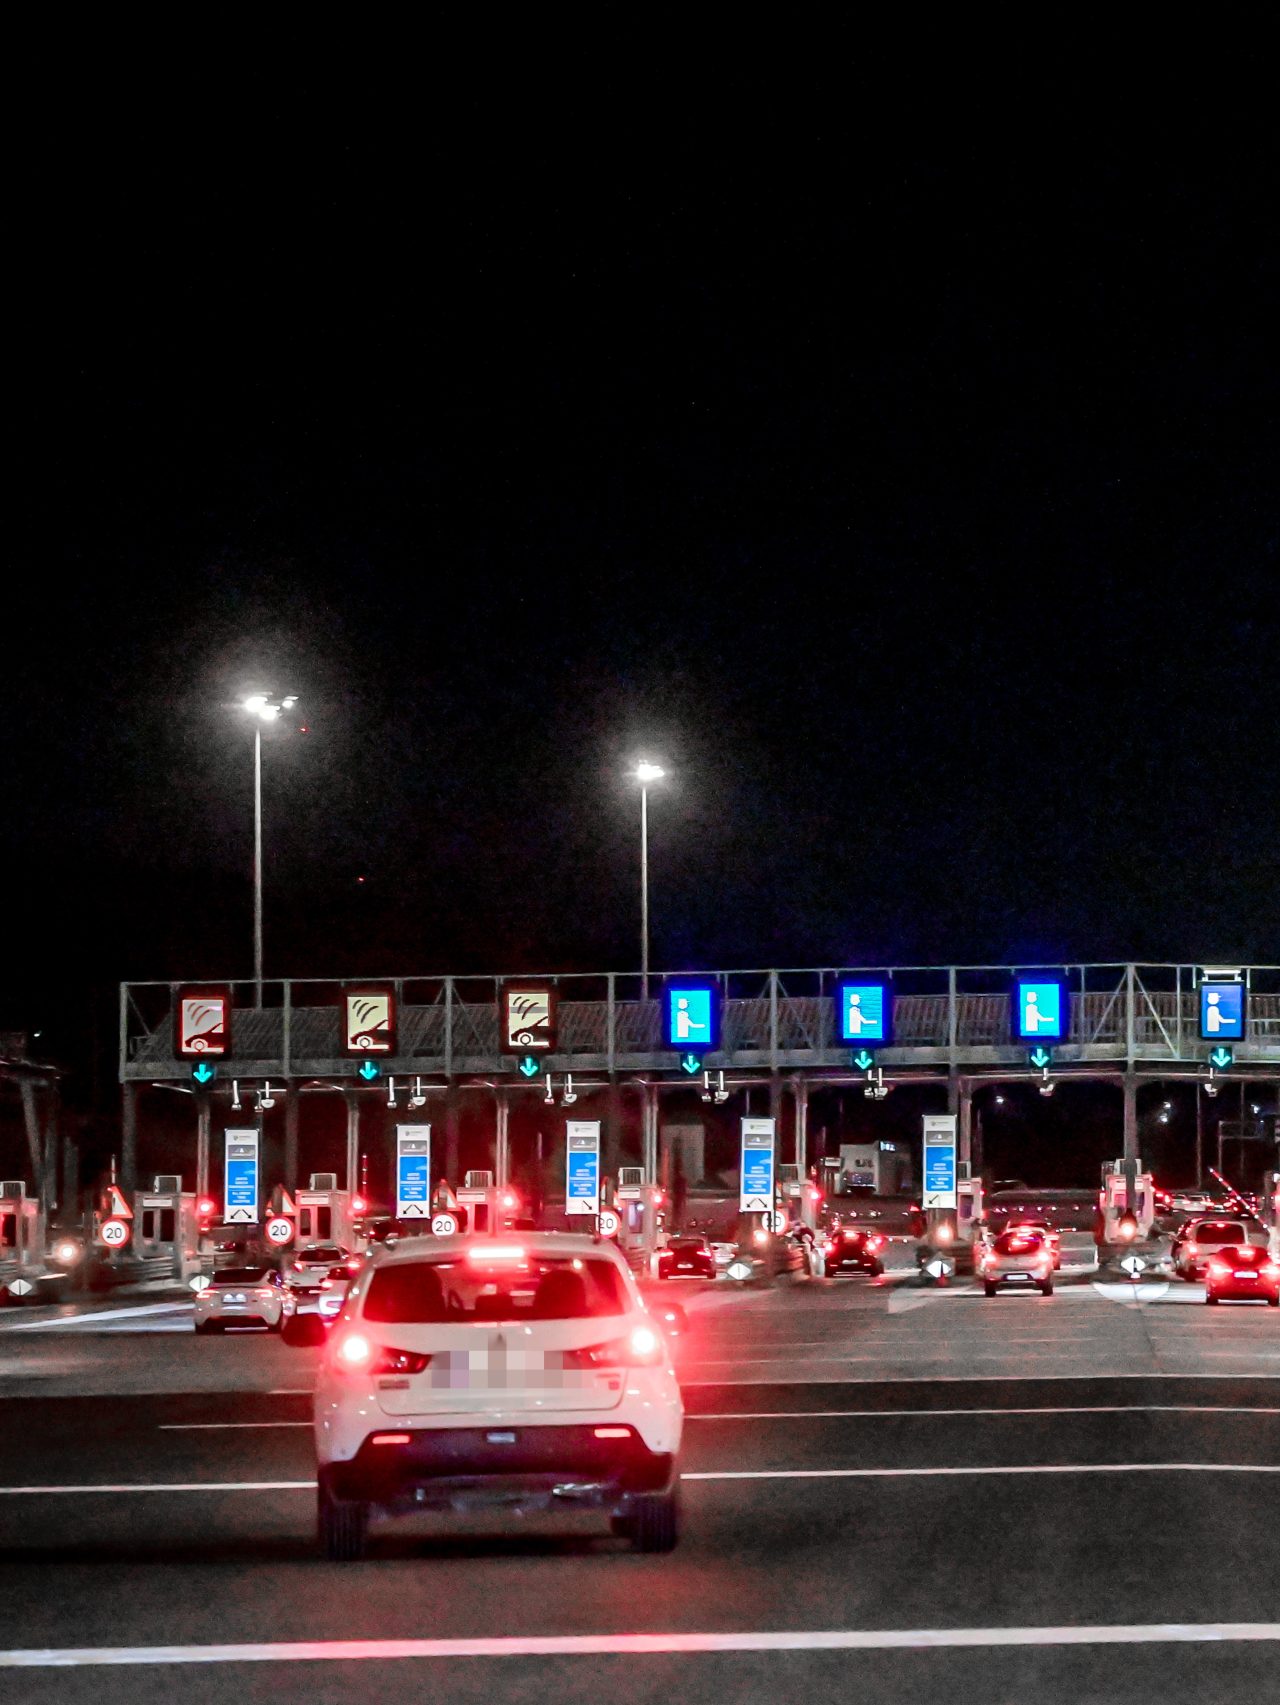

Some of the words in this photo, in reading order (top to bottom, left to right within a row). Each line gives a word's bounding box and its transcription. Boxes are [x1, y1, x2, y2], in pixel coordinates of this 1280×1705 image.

[271, 1225, 288, 1236] 20
[435, 1220, 452, 1232] 20
[106, 1227, 122, 1239] 20
